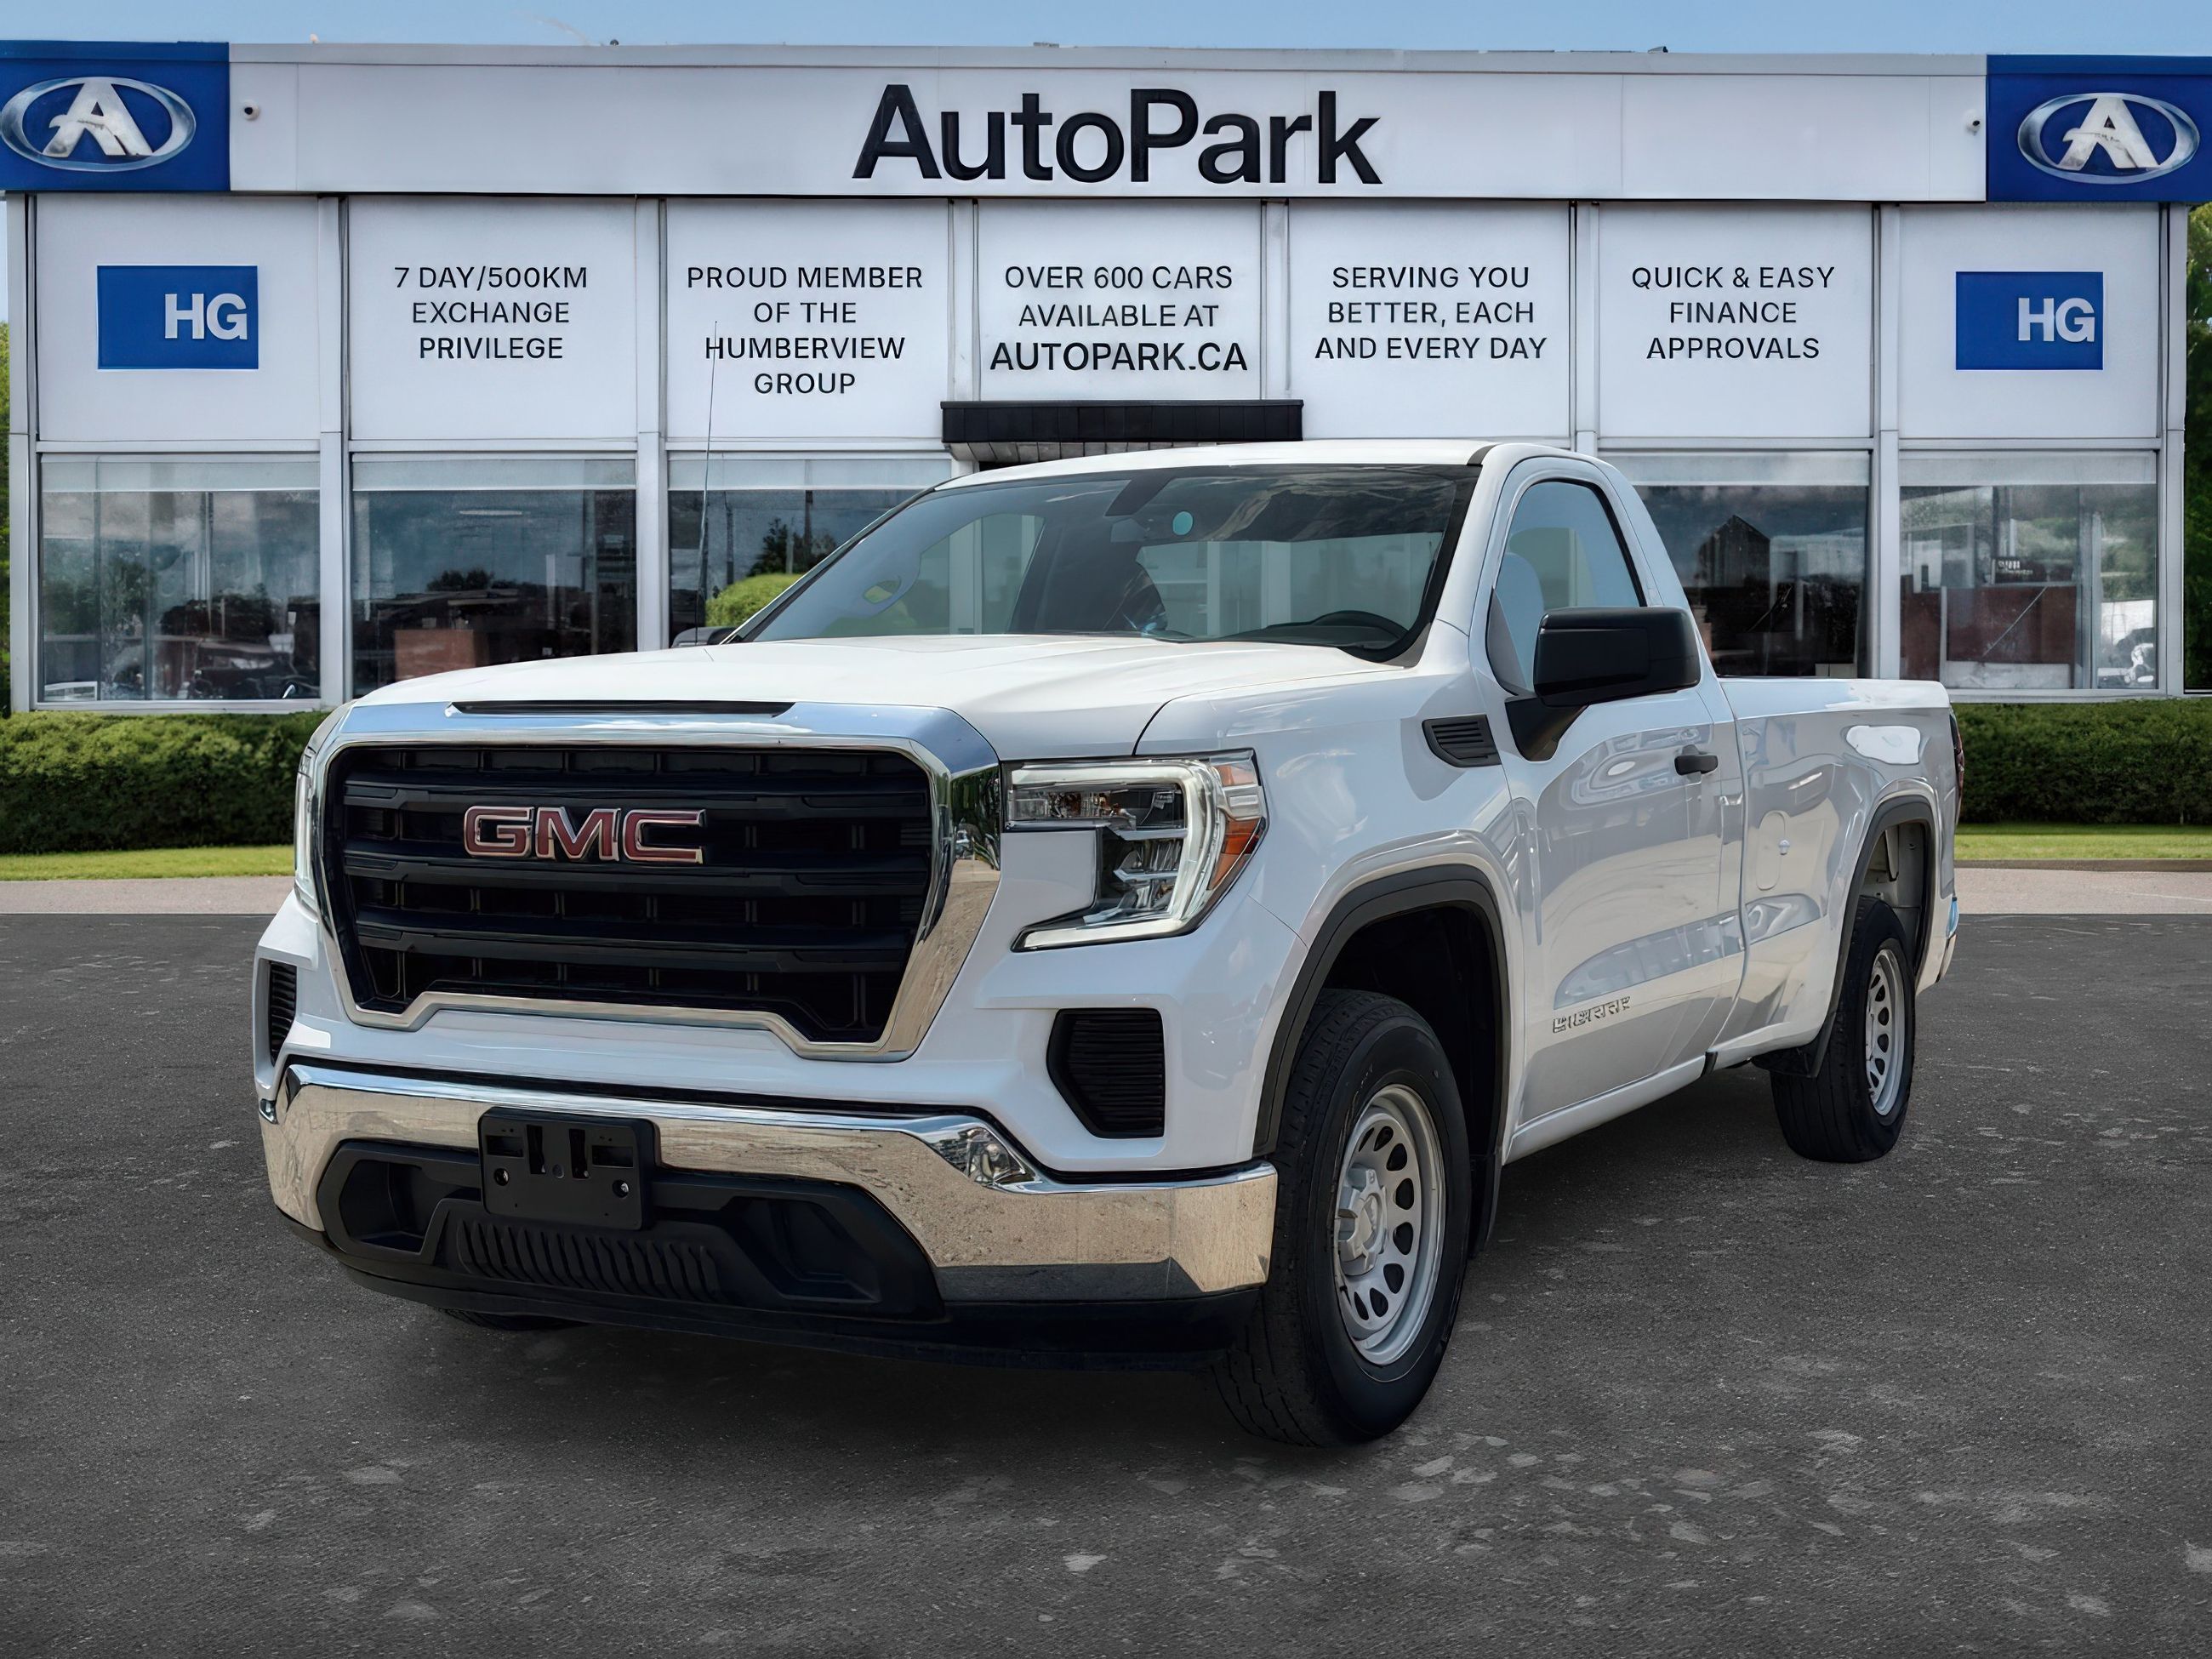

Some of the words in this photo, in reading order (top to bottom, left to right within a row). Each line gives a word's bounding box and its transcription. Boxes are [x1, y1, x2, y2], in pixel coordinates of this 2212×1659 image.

[852, 84, 1383, 185] AutoPark
[394, 266, 410, 288] 7
[419, 265, 587, 291] DAY/500KM
[687, 266, 787, 288] PROUD
[798, 266, 923, 288] MEMBER
[1005, 265, 1084, 289] OVER
[1094, 266, 1143, 289] 600
[1152, 265, 1233, 289] CARS
[1332, 266, 1459, 288] SERVING
[1468, 266, 1529, 288] YOU
[1632, 266, 1724, 290] QUICK
[1732, 266, 1750, 288] &
[1759, 266, 1835, 288] EASY
[164, 293, 248, 340] HG
[413, 301, 569, 324] EXCHANGE
[754, 302, 790, 323] OF
[800, 301, 857, 323] THE
[1018, 304, 1176, 328] AVAILABLE
[1183, 304, 1219, 328] AT
[1328, 301, 1445, 328] BETTER,
[1456, 301, 1534, 324] EACH
[1670, 301, 1797, 324] FINANCE
[2018, 298, 2095, 342] HG
[419, 337, 563, 360] PRIVILEGE
[705, 337, 905, 361] HUMBERVIEW
[989, 342, 1248, 372] AUTOPARK.CA
[1314, 337, 1377, 360] AND
[1387, 337, 1480, 359] EVERY
[1491, 337, 1548, 359] DAY
[1646, 337, 1820, 360] APPROVALS
[754, 373, 856, 395] GROUP
[464, 805, 705, 864] GMC
